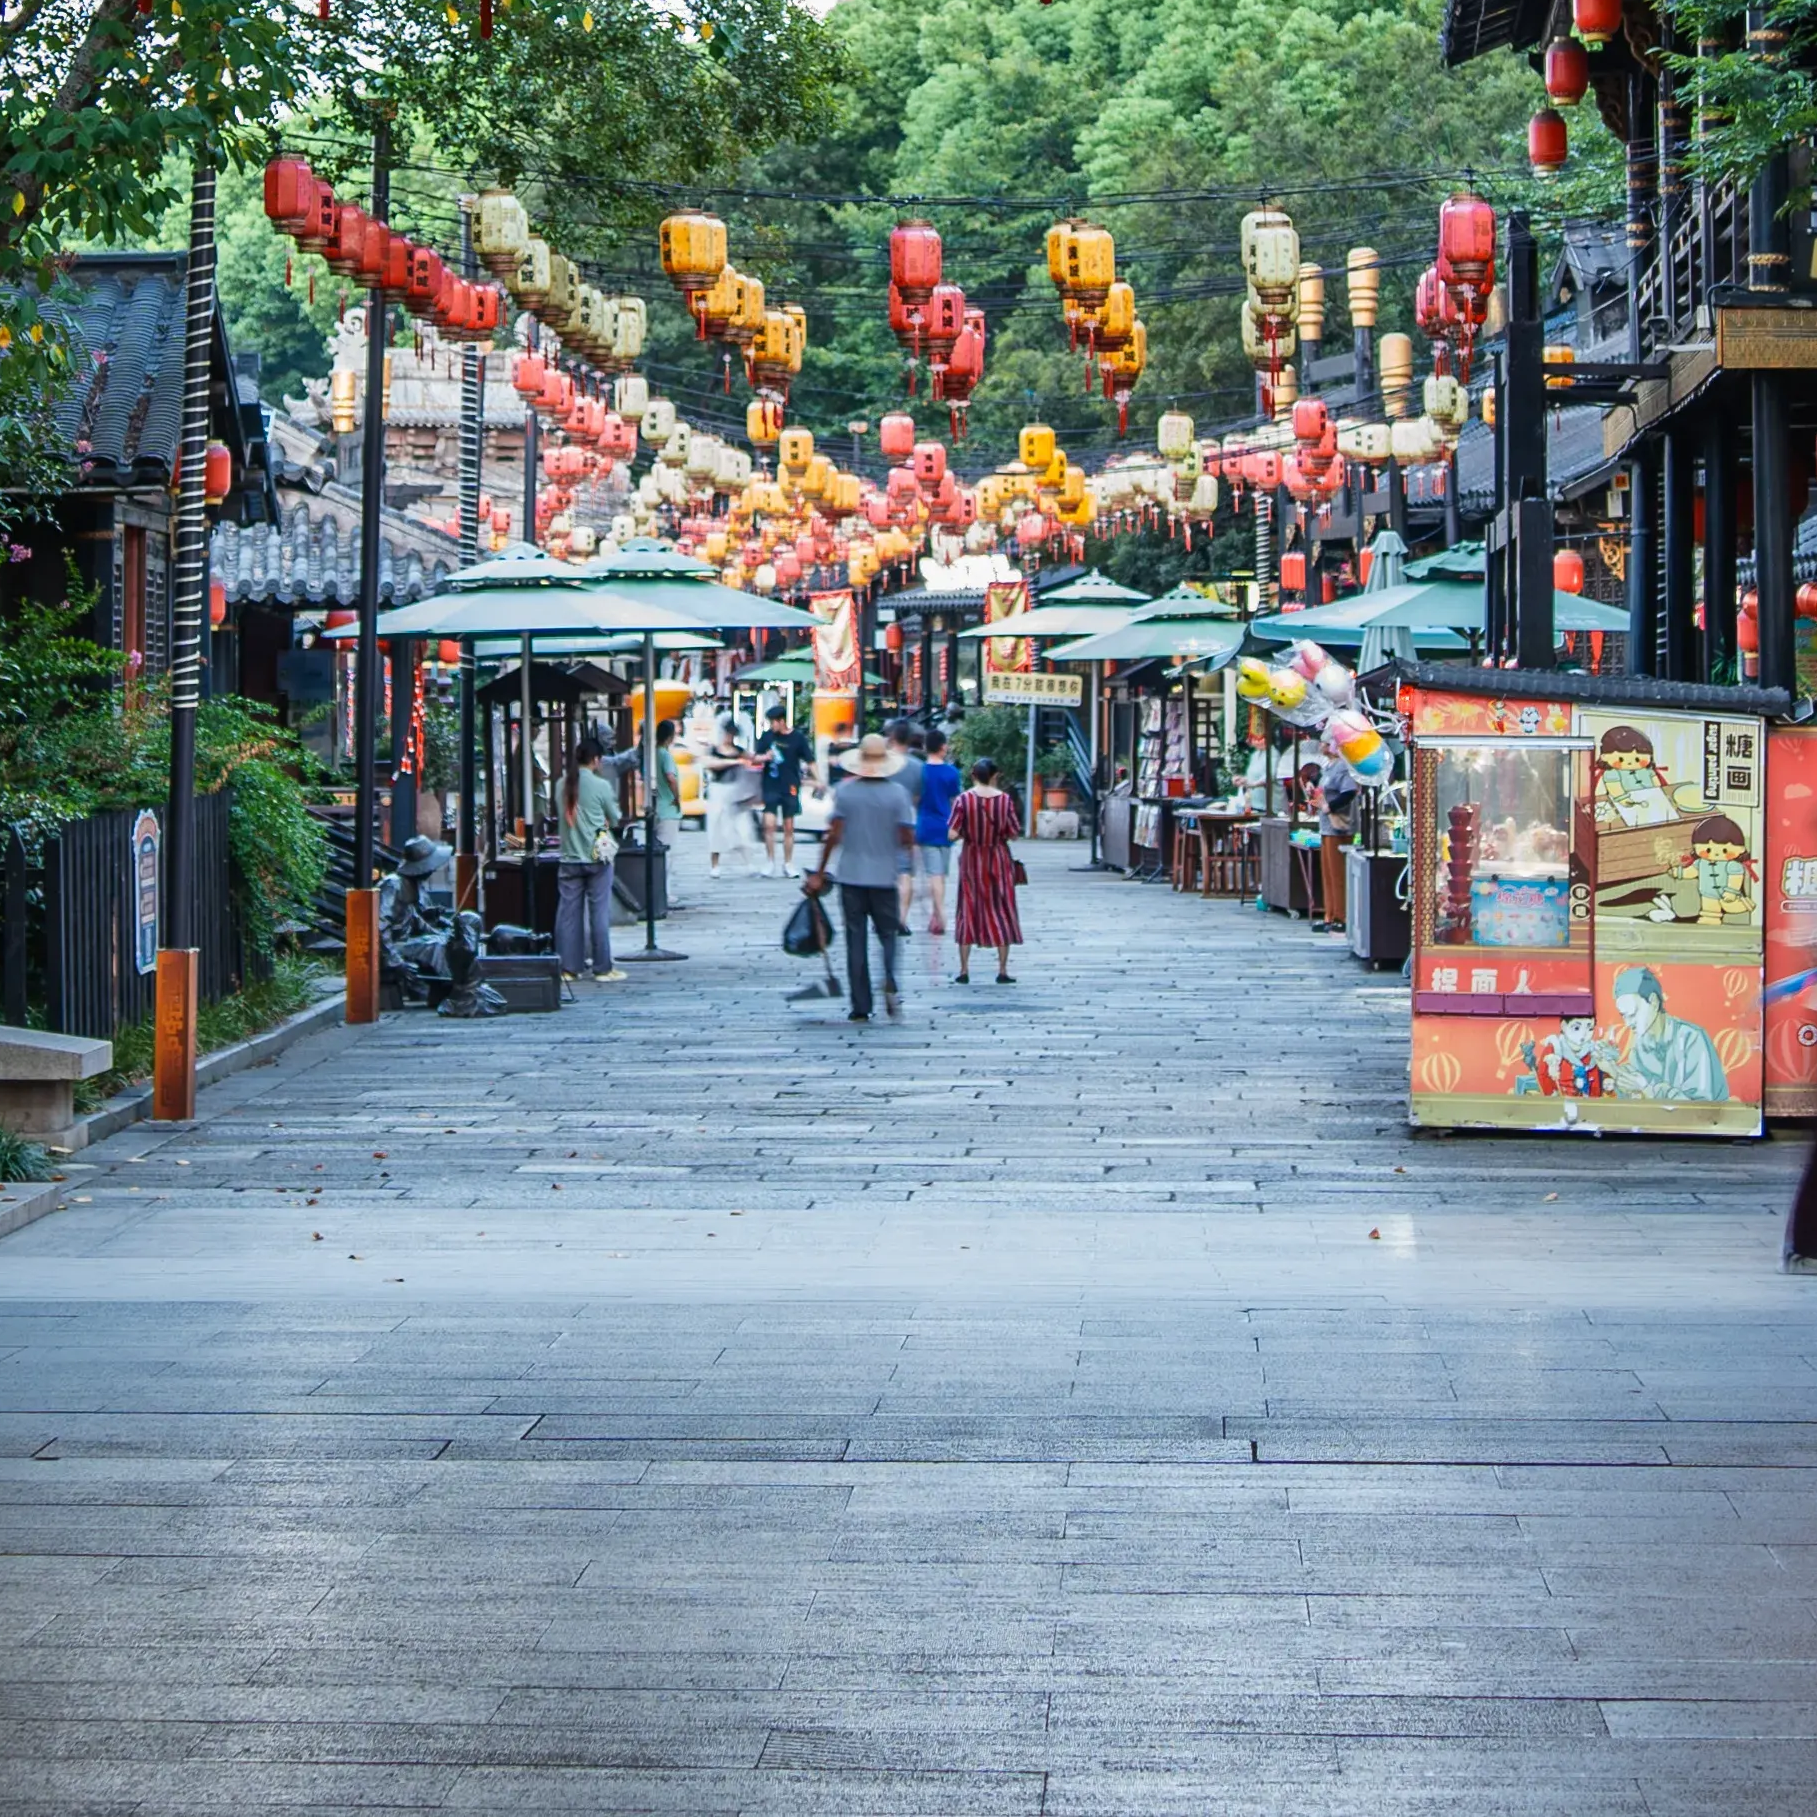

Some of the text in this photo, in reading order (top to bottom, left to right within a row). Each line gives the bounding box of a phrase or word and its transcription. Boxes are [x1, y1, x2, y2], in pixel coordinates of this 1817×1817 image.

[1726, 733, 1753, 790] 糖画
[1432, 967, 1532, 994] 捏面人
